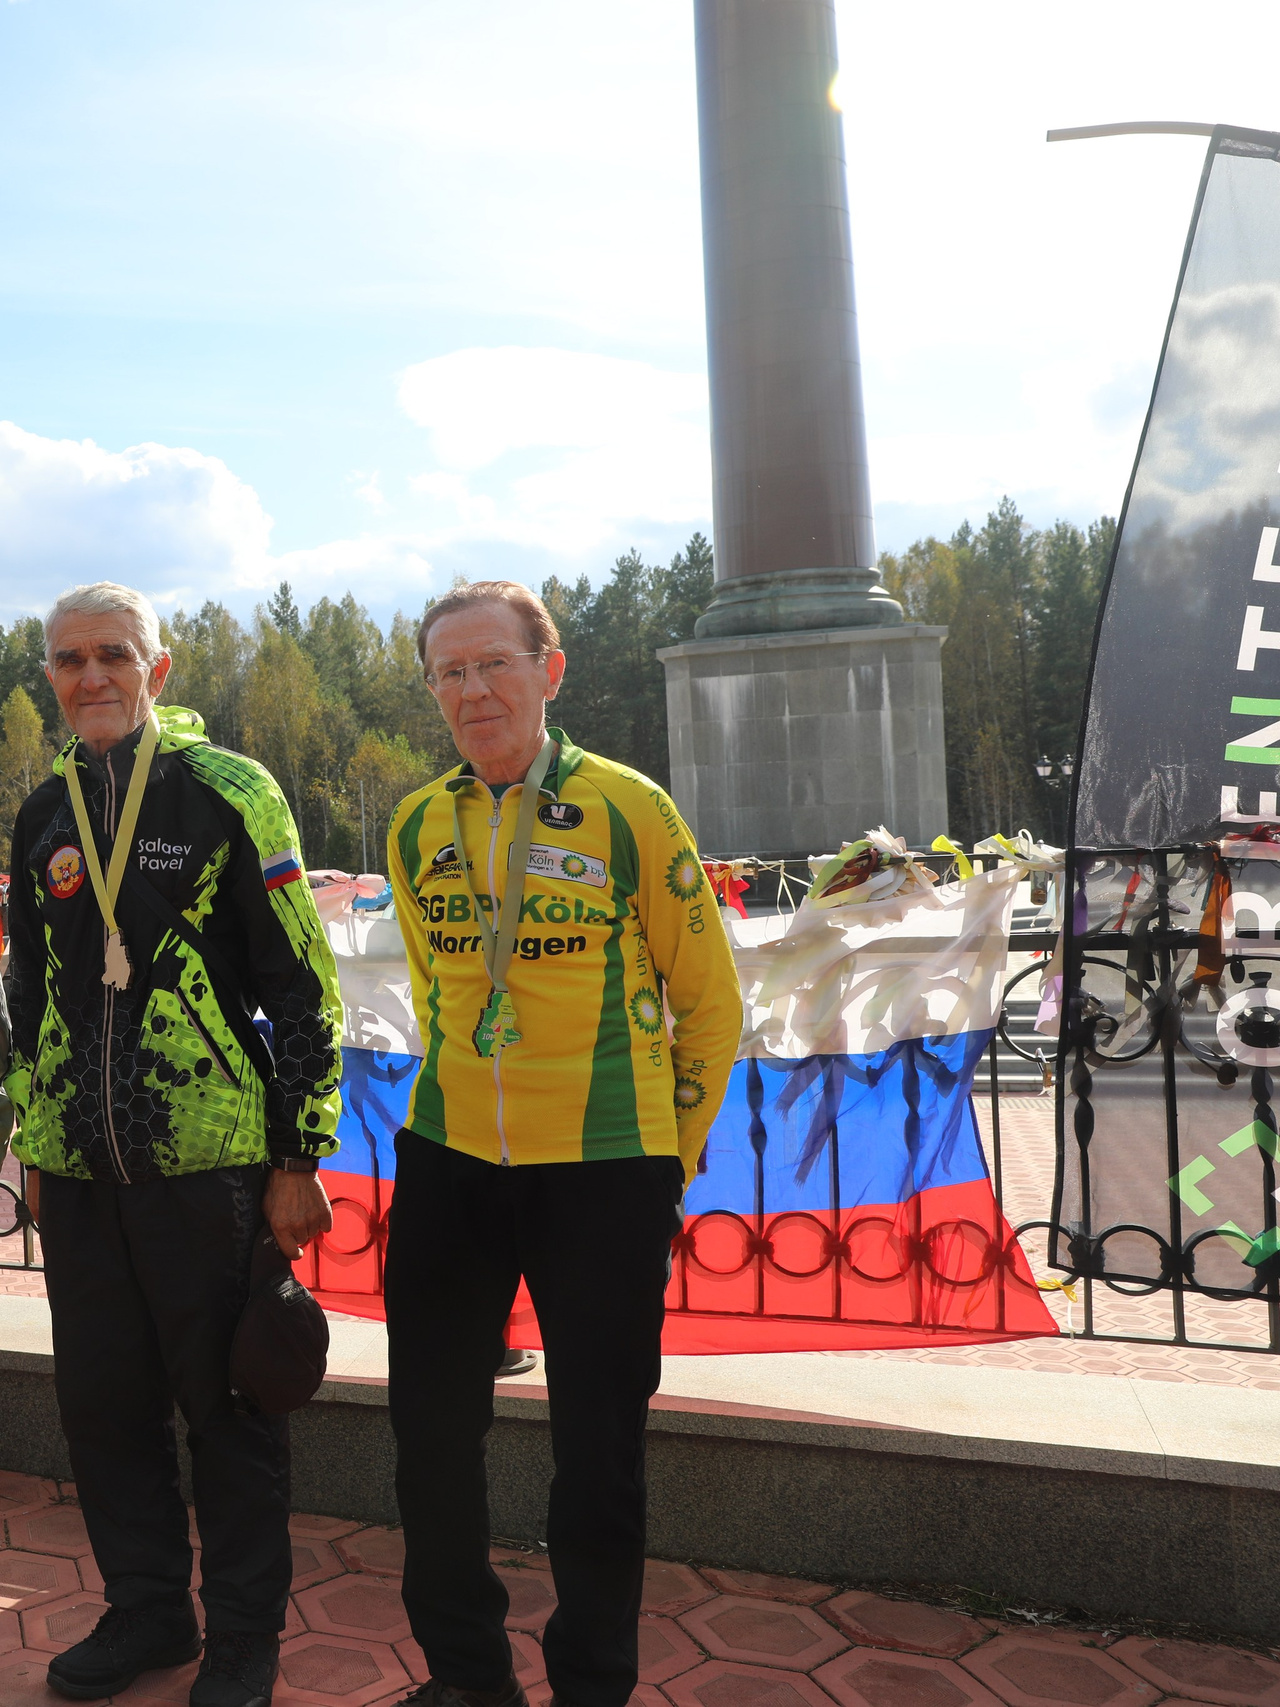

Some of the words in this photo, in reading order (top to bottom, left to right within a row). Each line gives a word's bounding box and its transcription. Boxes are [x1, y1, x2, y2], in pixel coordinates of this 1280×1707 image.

[544, 817, 573, 828] VERMARC
[649, 790, 680, 838] Köln
[137, 837, 193, 856] Salaev
[139, 855, 184, 871] Pavel
[529, 853, 554, 866] Köln
[590, 865, 605, 878] bp
[518, 894, 608, 924] Köln
[688, 903, 705, 935] bp
[426, 930, 586, 961] Worrgen
[633, 931, 648, 977] Köln
[648, 1039, 663, 1068] bp
[686, 1059, 708, 1076] bp
